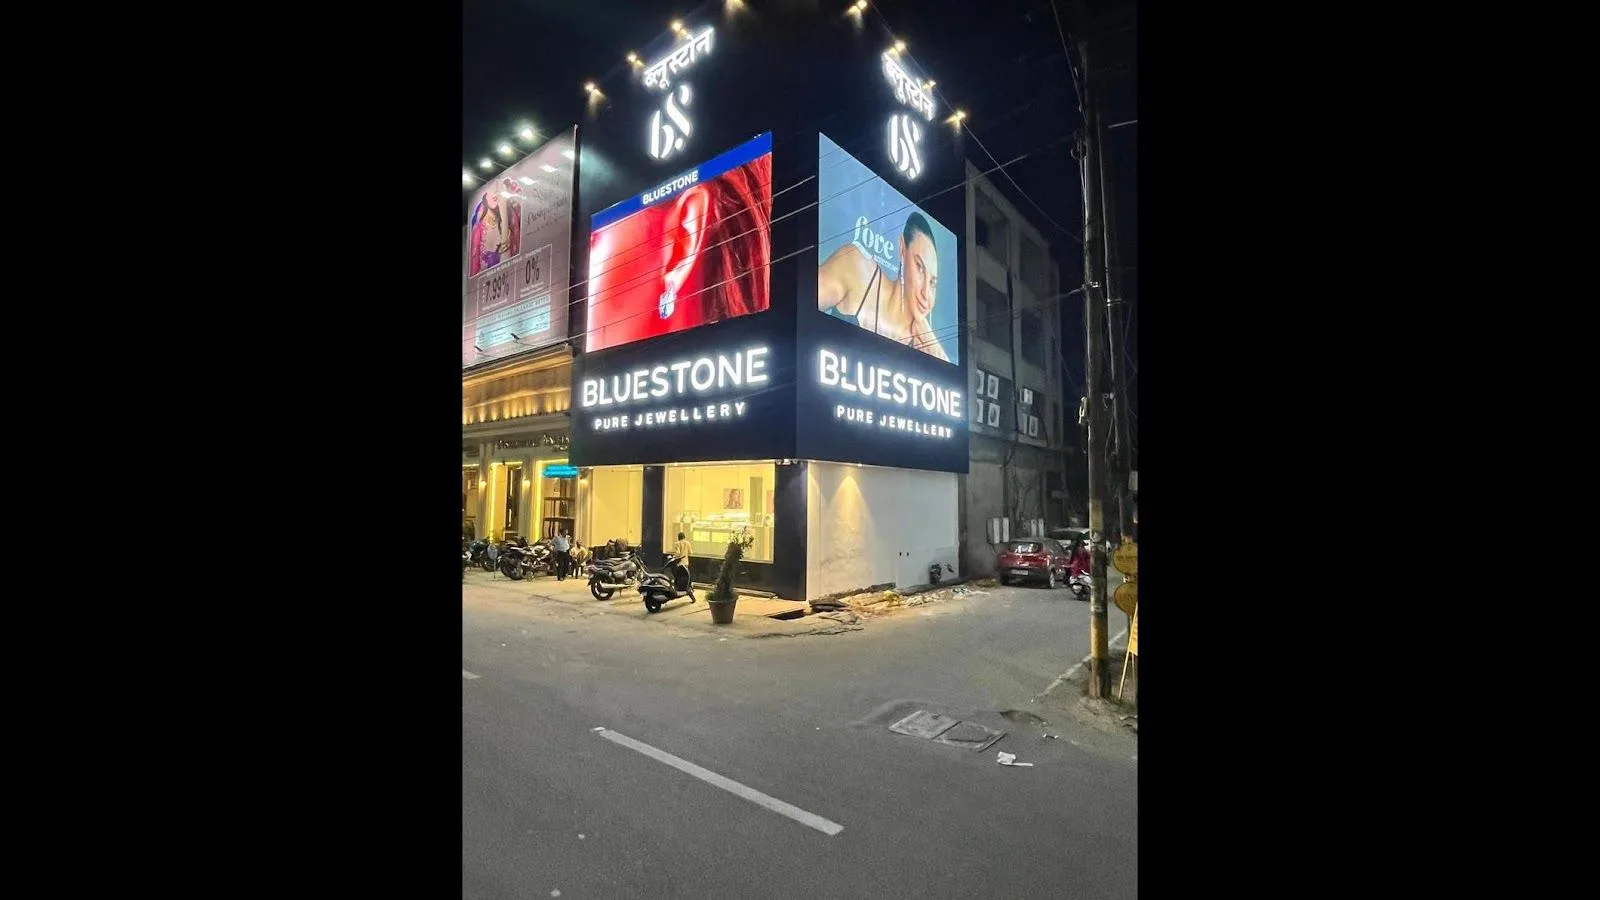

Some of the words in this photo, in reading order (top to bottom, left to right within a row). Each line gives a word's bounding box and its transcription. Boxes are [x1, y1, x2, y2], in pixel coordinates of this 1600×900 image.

[642, 171, 698, 205] BLUESTONE
[852, 216, 894, 259] Love
[582, 347, 768, 407] BLUESTONE
[819, 350, 961, 418] BLUESTONE
[594, 416, 627, 430] PURE
[635, 403, 746, 425] JEWELLERY
[837, 405, 872, 423] PURE
[880, 415, 952, 438] JEWELLERY
